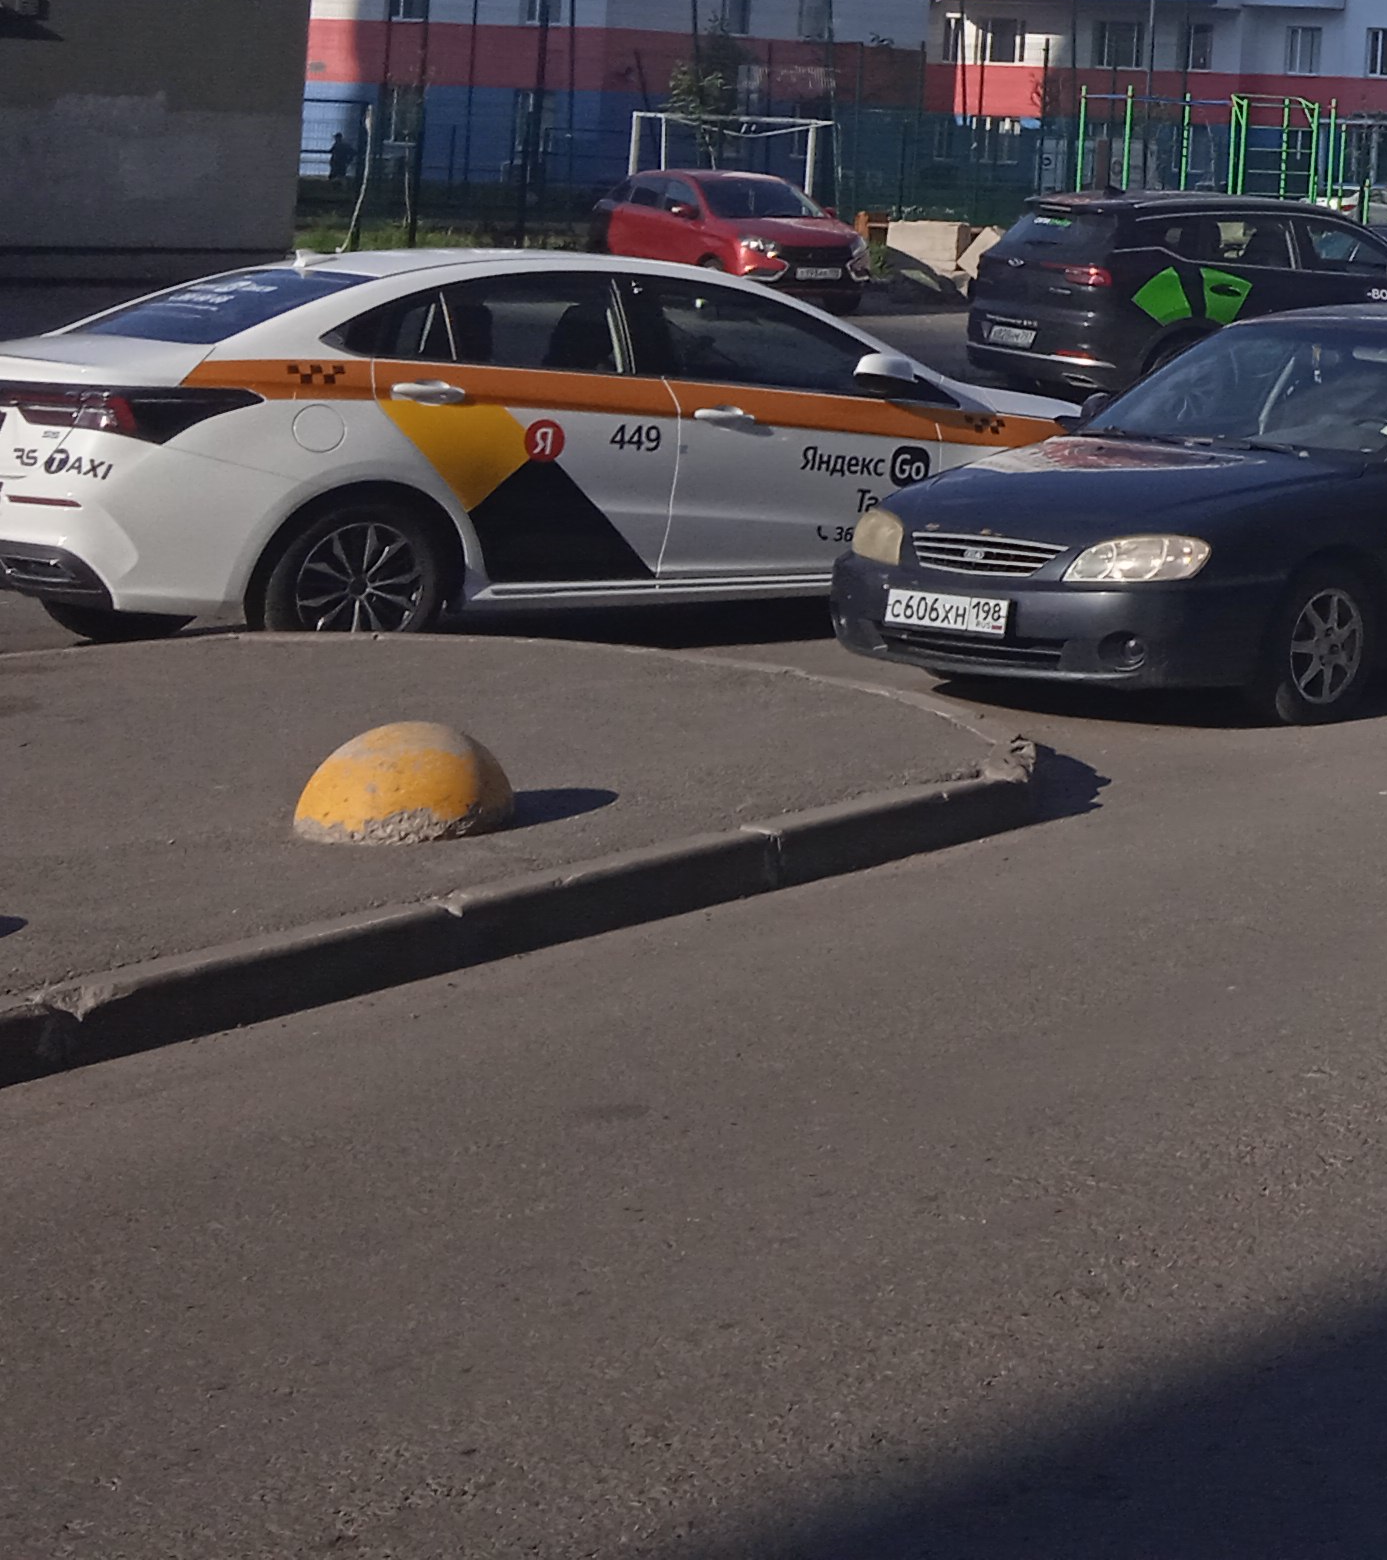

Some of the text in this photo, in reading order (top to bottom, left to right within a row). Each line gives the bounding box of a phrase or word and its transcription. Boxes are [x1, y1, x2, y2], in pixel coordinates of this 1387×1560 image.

[533, 427, 554, 455] Я
[609, 424, 661, 452] 449
[44, 448, 114, 481] TAXI
[801, 446, 885, 477] Яндекс
[894, 454, 926, 481] Go
[857, 488, 880, 513] Та
[833, 526, 854, 542] 36
[891, 595, 1002, 627] С606ХН 198
